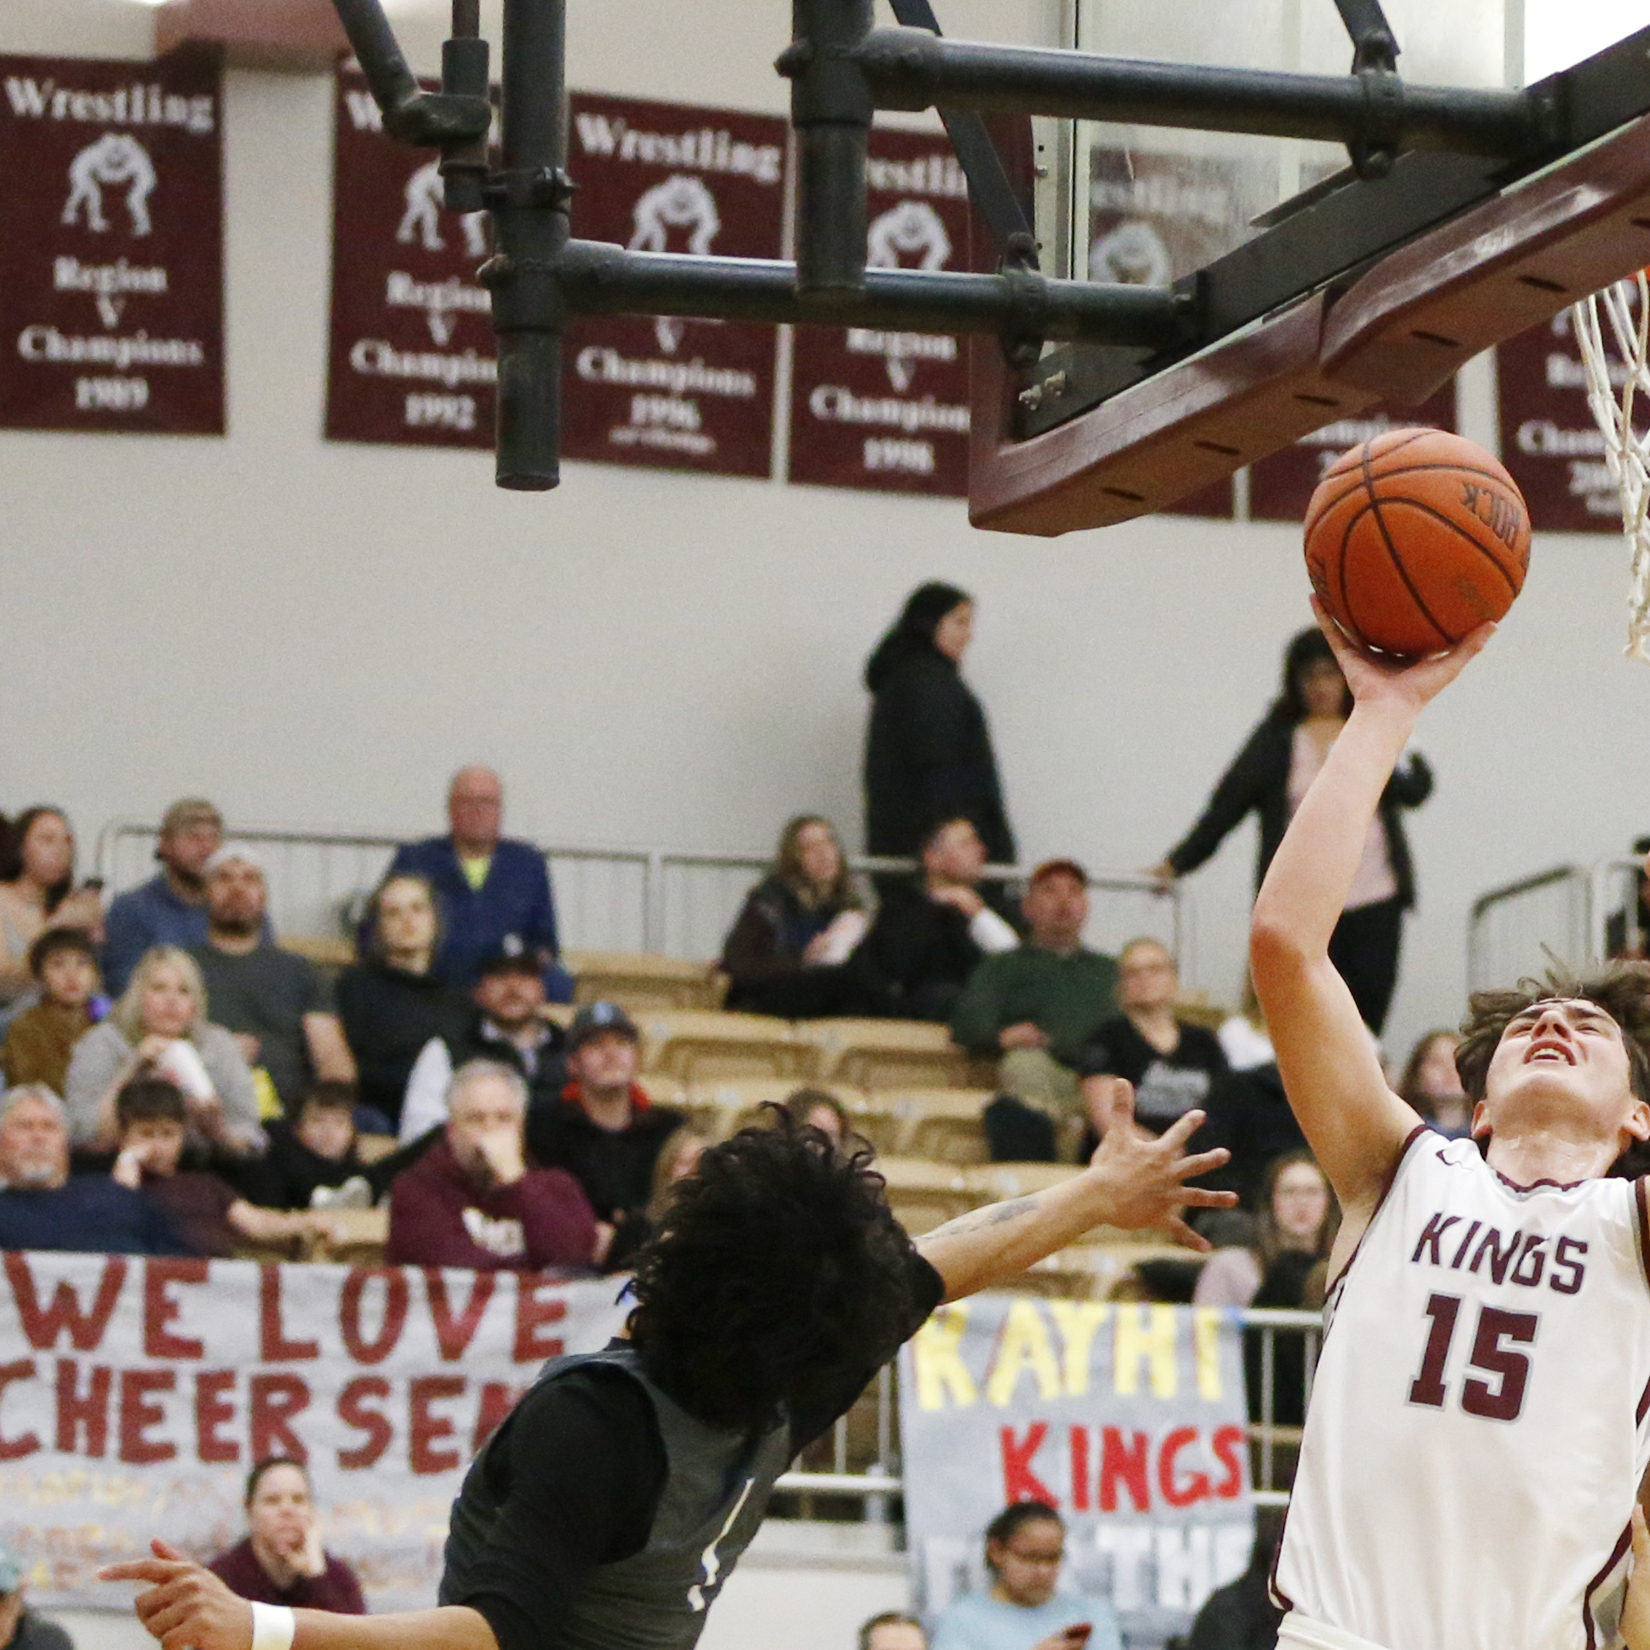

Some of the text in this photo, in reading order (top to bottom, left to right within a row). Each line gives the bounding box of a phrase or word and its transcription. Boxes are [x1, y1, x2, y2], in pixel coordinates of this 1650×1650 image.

[5, 76, 214, 132] Wrestling
[574, 111, 782, 184] Wrestling
[54, 256, 167, 296] Region
[17, 324, 204, 370] Champions
[575, 345, 756, 399] Champions
[1411, 1212, 1588, 1295] KINGS
[3, 1252, 568, 1364] WE LOVE
[1408, 1288, 1542, 1424] 15
[0, 1358, 309, 1465] CHEER
[1000, 1420, 1246, 1514] KINGS
